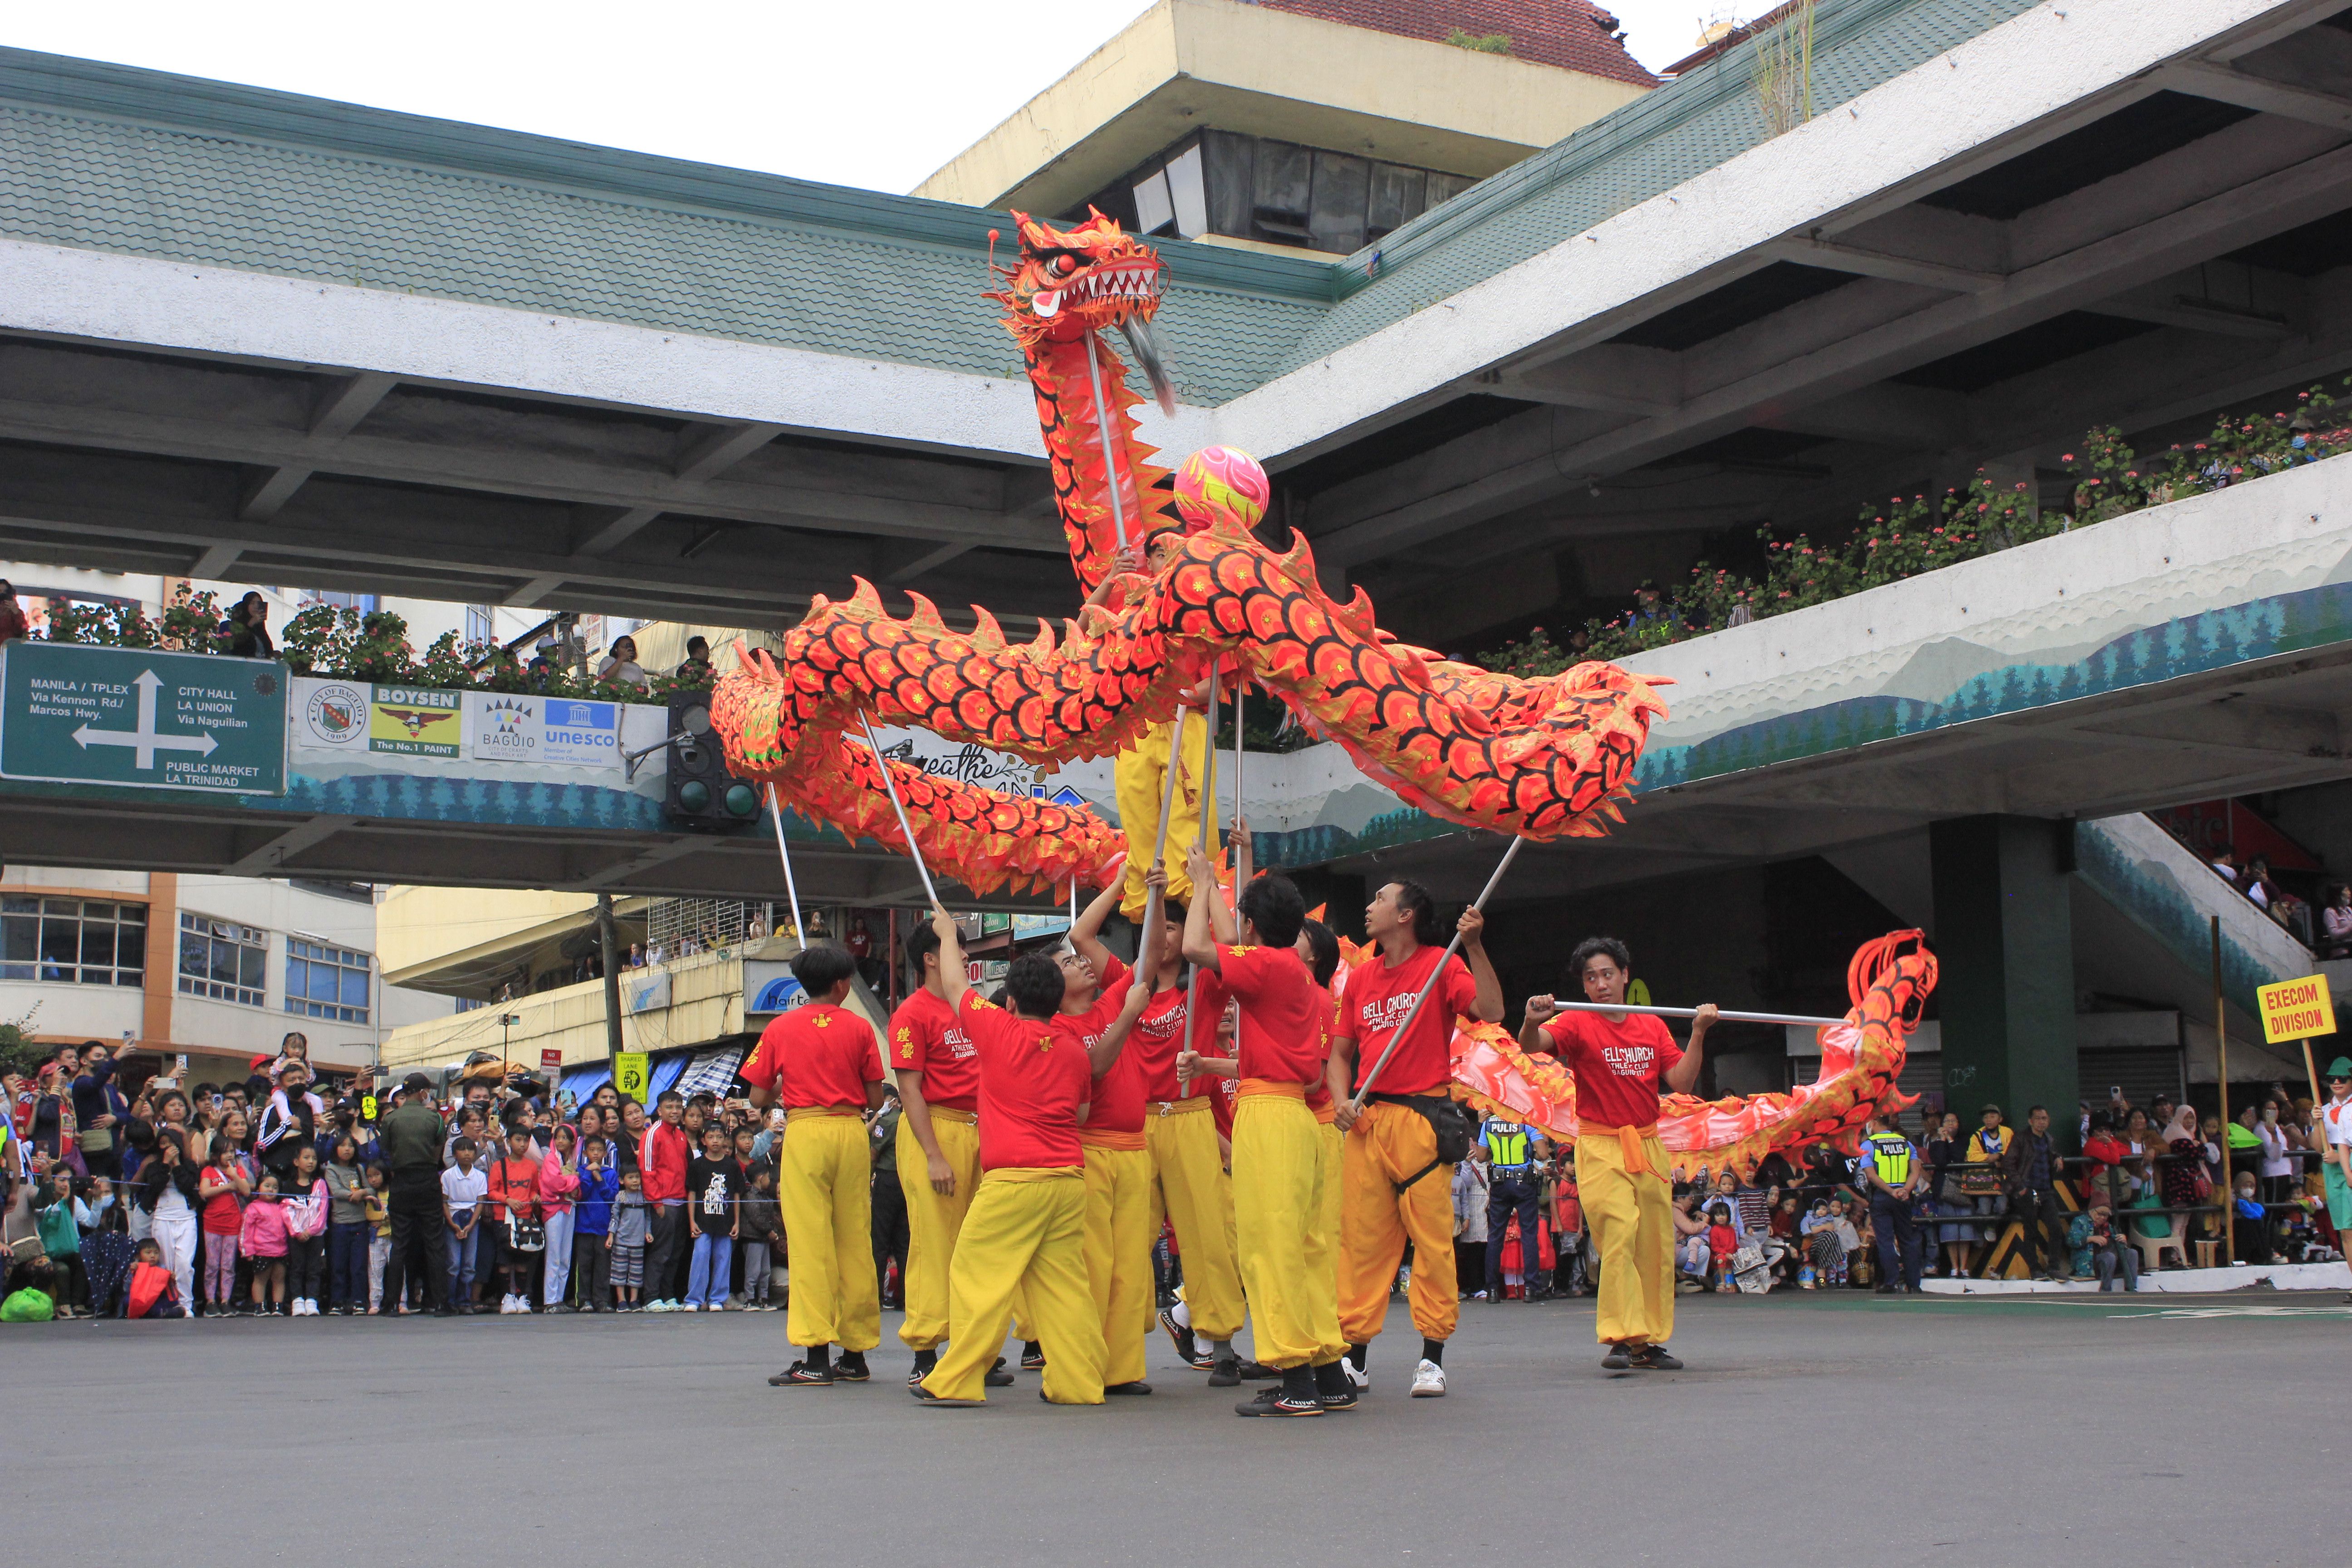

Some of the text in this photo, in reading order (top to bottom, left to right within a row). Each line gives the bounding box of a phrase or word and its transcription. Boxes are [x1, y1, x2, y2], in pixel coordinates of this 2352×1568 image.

[30, 678, 129, 695] MANILA / TPLEX
[178, 686, 237, 700] CITY HALL
[30, 692, 124, 708] Via Kennon Rd./
[310, 688, 363, 717] CITY OF BAGUIO
[378, 688, 454, 708] BOYSEN
[29, 704, 102, 720] Marcos Hwy.
[177, 701, 233, 713] LA UNION
[177, 714, 248, 728] Via Naguilian
[326, 731, 347, 740] 1909
[483, 734, 535, 748] BAGUIO
[546, 730, 615, 747] unesco
[377, 741, 394, 750] The
[424, 745, 453, 754] PAINT
[166, 761, 259, 777] PUBLIC MARKET
[165, 774, 239, 787] LA TRINIDAD
[2265, 983, 2318, 1010] EXECOM
[1363, 1000, 1384, 1020] BELL
[2271, 1009, 2323, 1035] DIVISION
[944, 1028, 962, 1045] BELL
[1166, 1029, 1178, 1038] CIT
[951, 1043, 975, 1052] ATHLETIC
[955, 1049, 975, 1058] BAGUIO
[1601, 1046, 1622, 1062] ELL
[1634, 1062, 1649, 1070] CLUB
[1221, 1078, 1237, 1093] BELL
[1491, 1123, 1518, 1133] PULIS
[1882, 1143, 1905, 1154] PULIS
